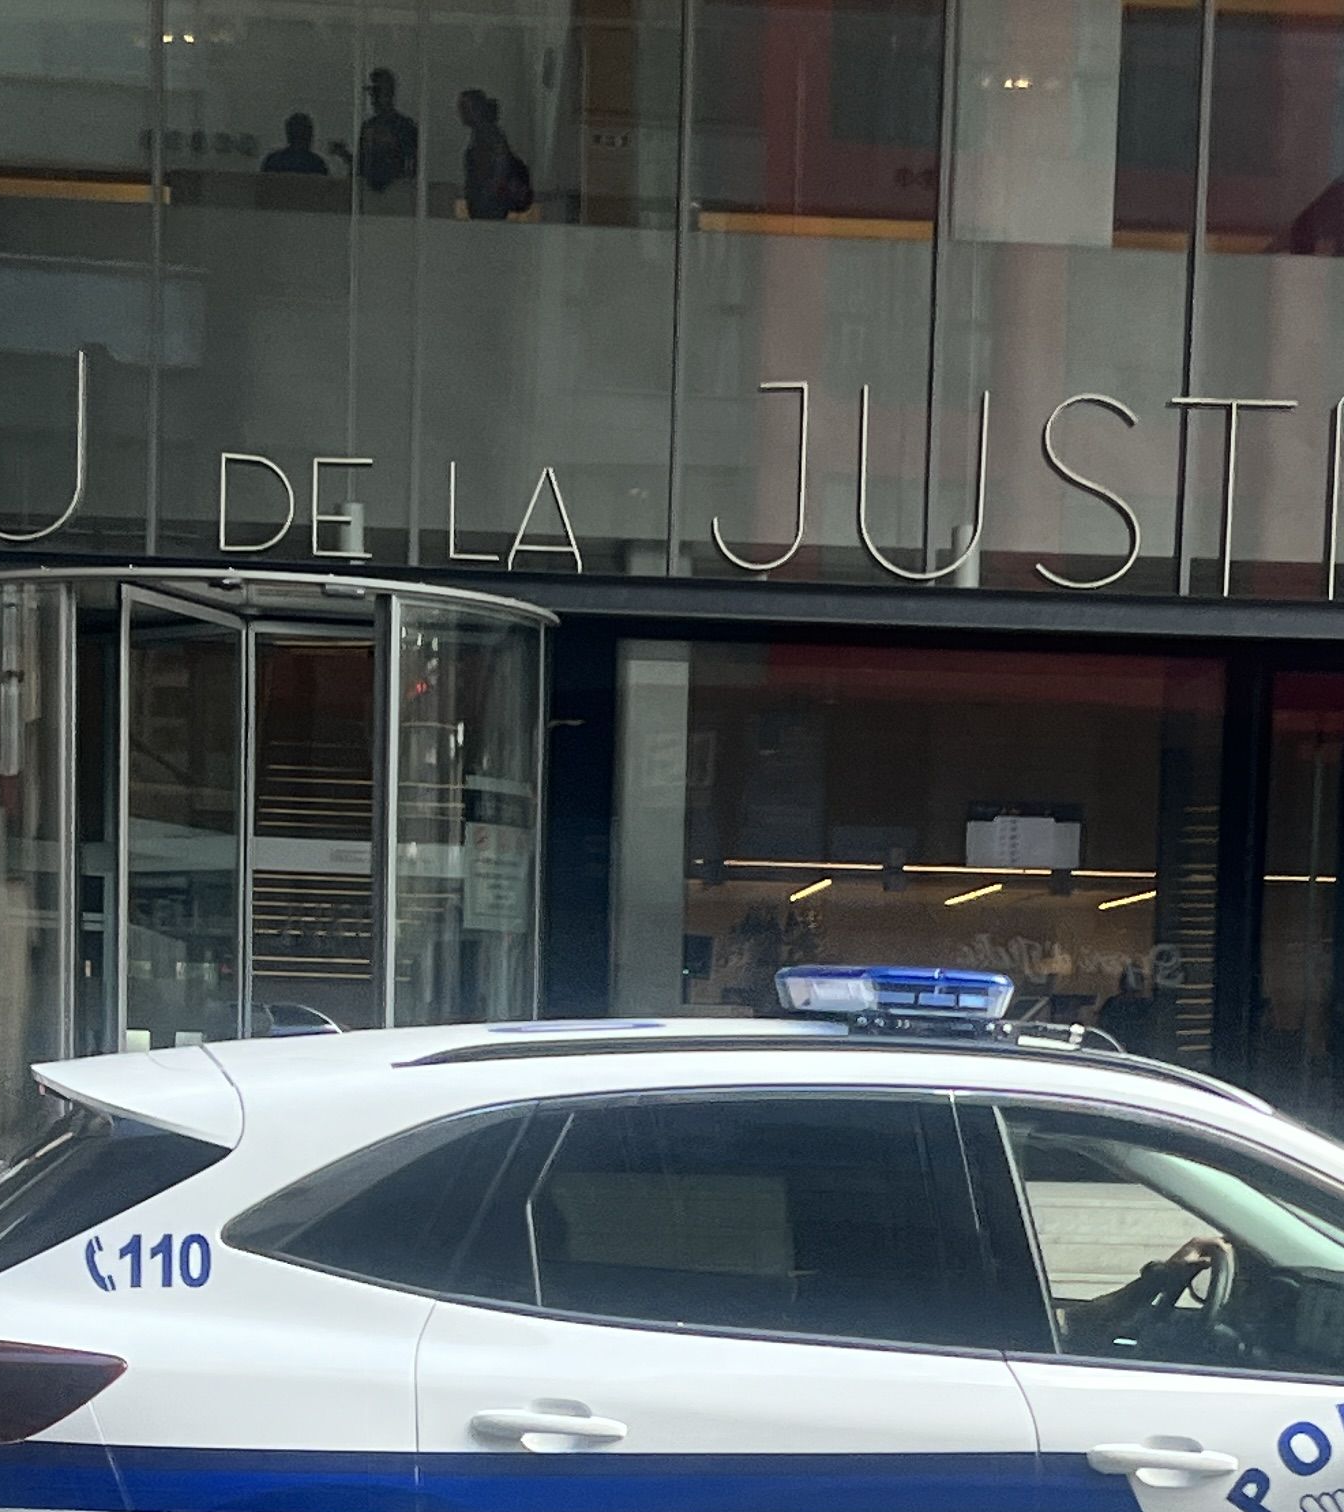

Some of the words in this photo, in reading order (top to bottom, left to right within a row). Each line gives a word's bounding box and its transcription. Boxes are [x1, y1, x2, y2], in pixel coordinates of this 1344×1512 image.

[218, 452, 375, 560] DE
[448, 459, 584, 574] LA
[118, 1232, 212, 1288] 110
